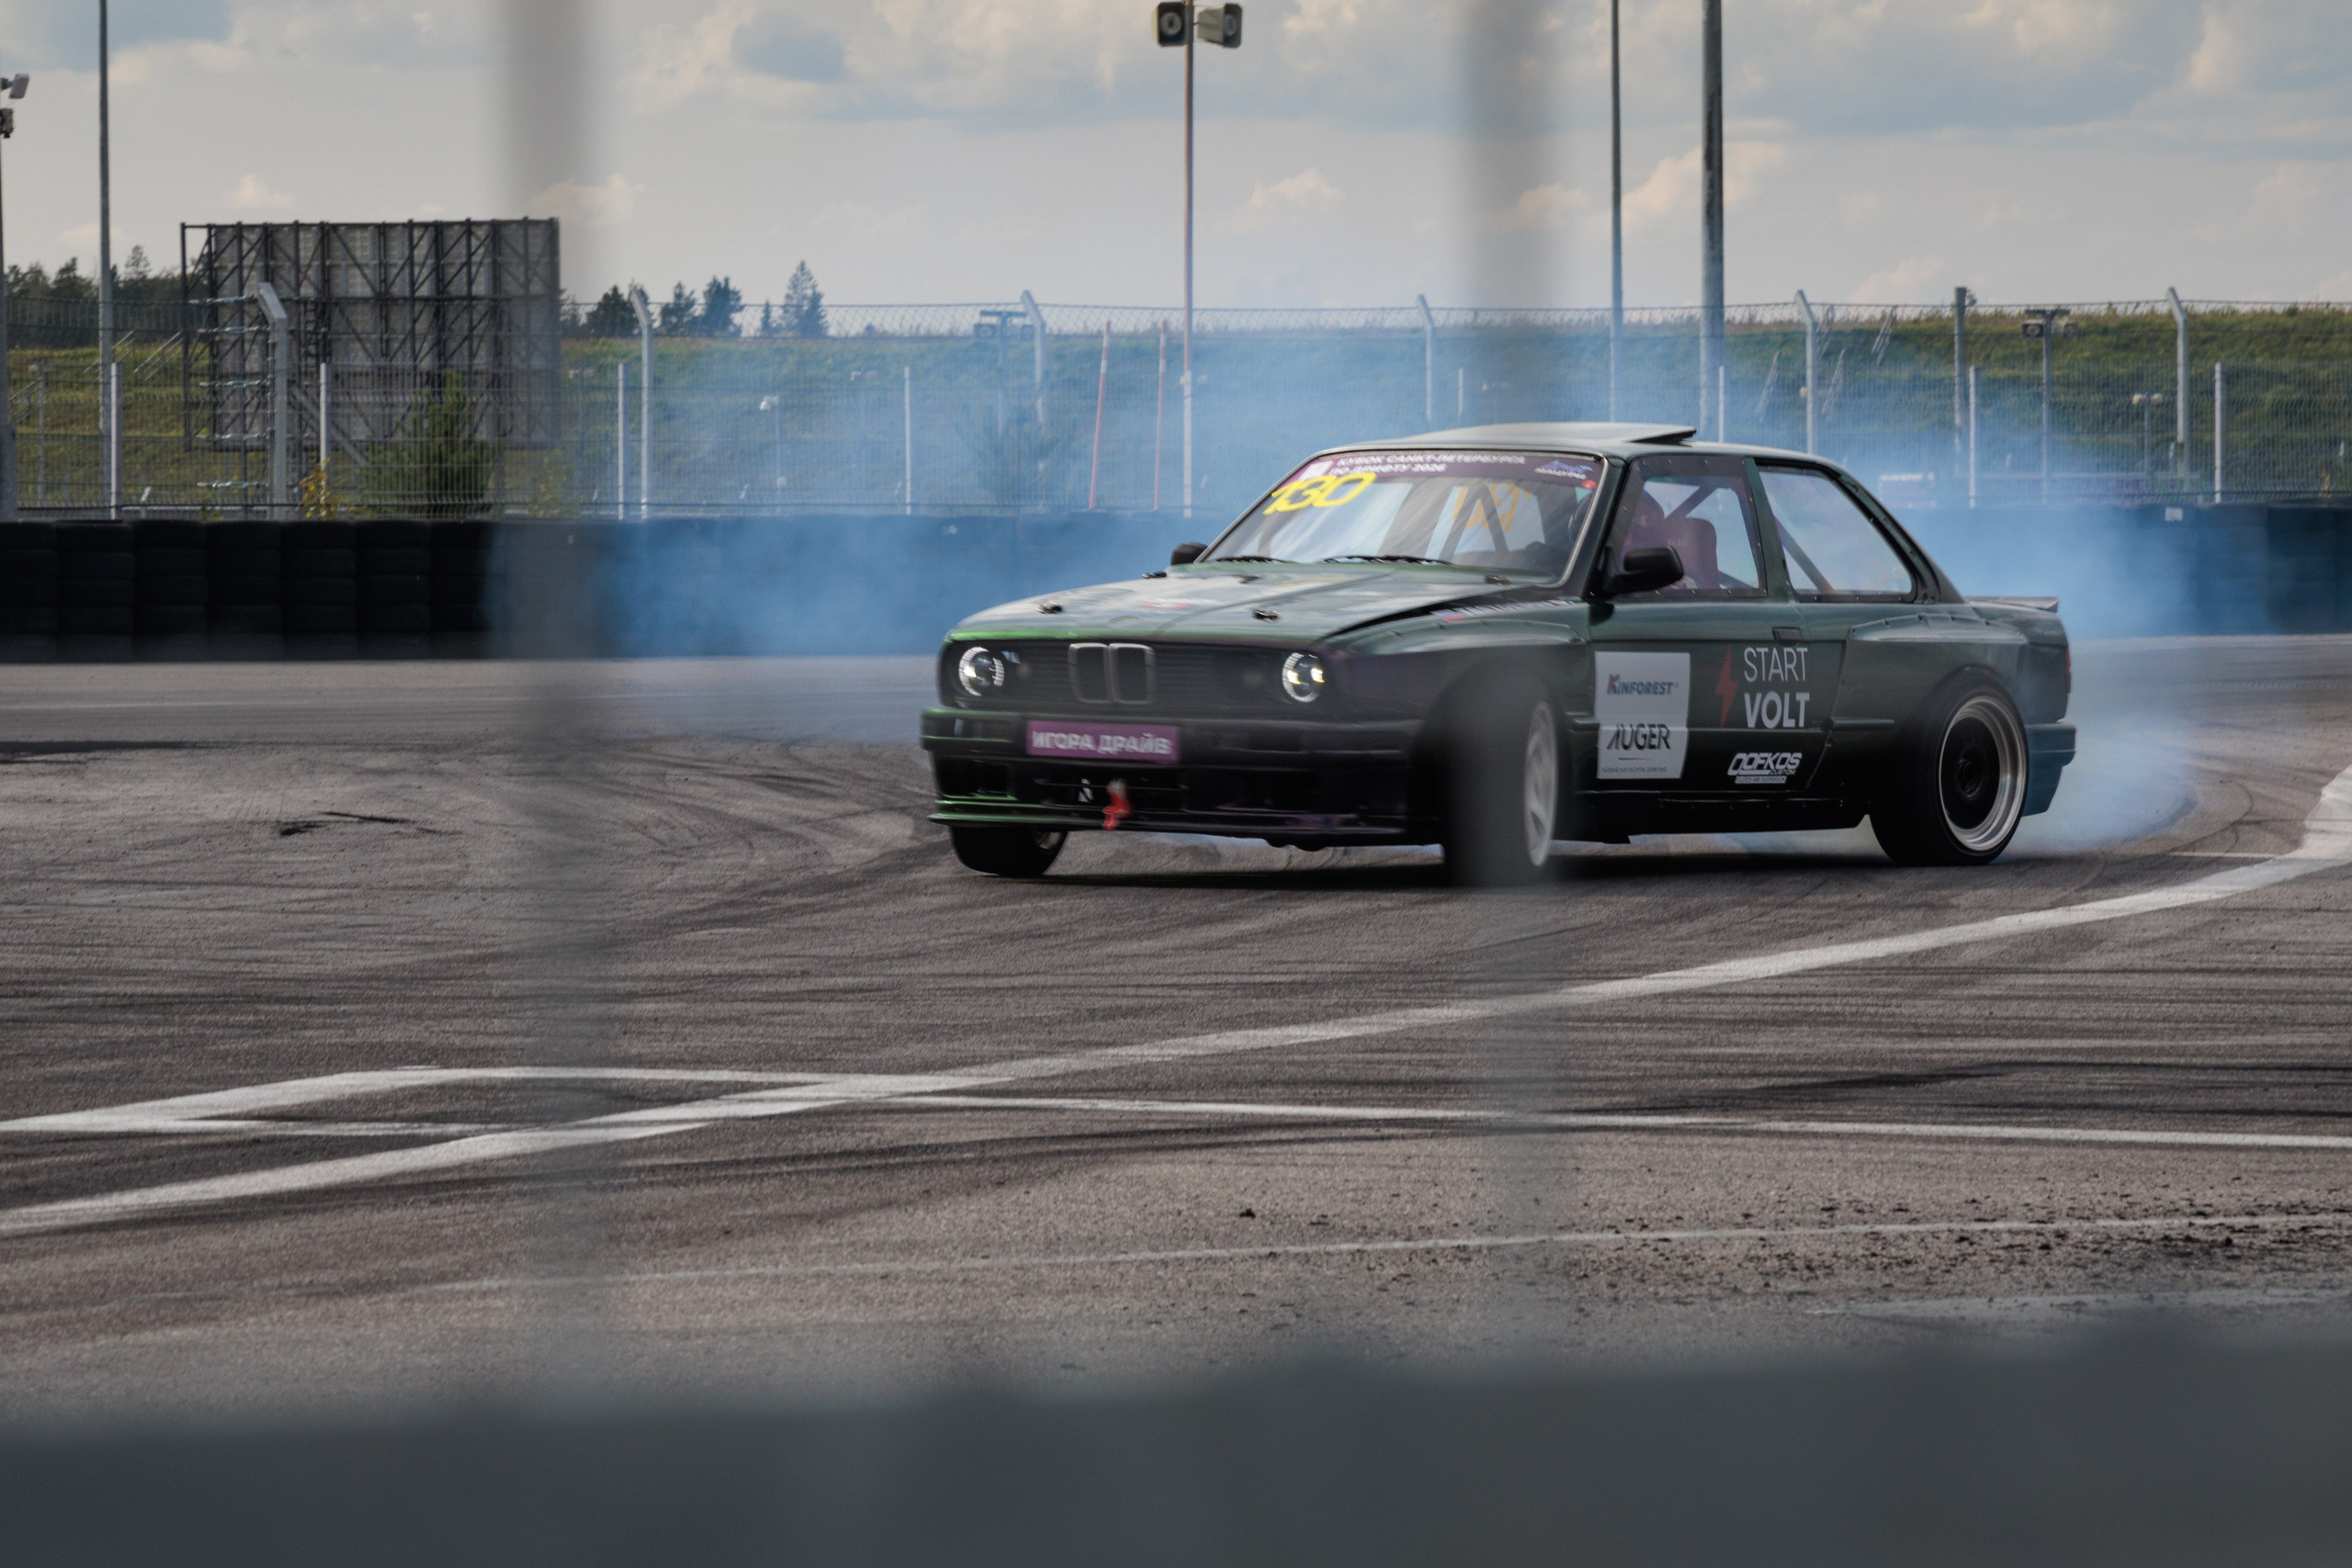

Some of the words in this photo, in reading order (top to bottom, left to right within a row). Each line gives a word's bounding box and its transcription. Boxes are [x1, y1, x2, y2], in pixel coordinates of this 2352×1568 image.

[1262, 472, 1376, 515] 130
[1744, 647, 1808, 682] START
[1606, 673, 1674, 695] KINFOREST
[1744, 692, 1810, 728] VOLT
[1032, 731, 1094, 751] ИГОРА
[1097, 732, 1172, 755] ДРАЙВ
